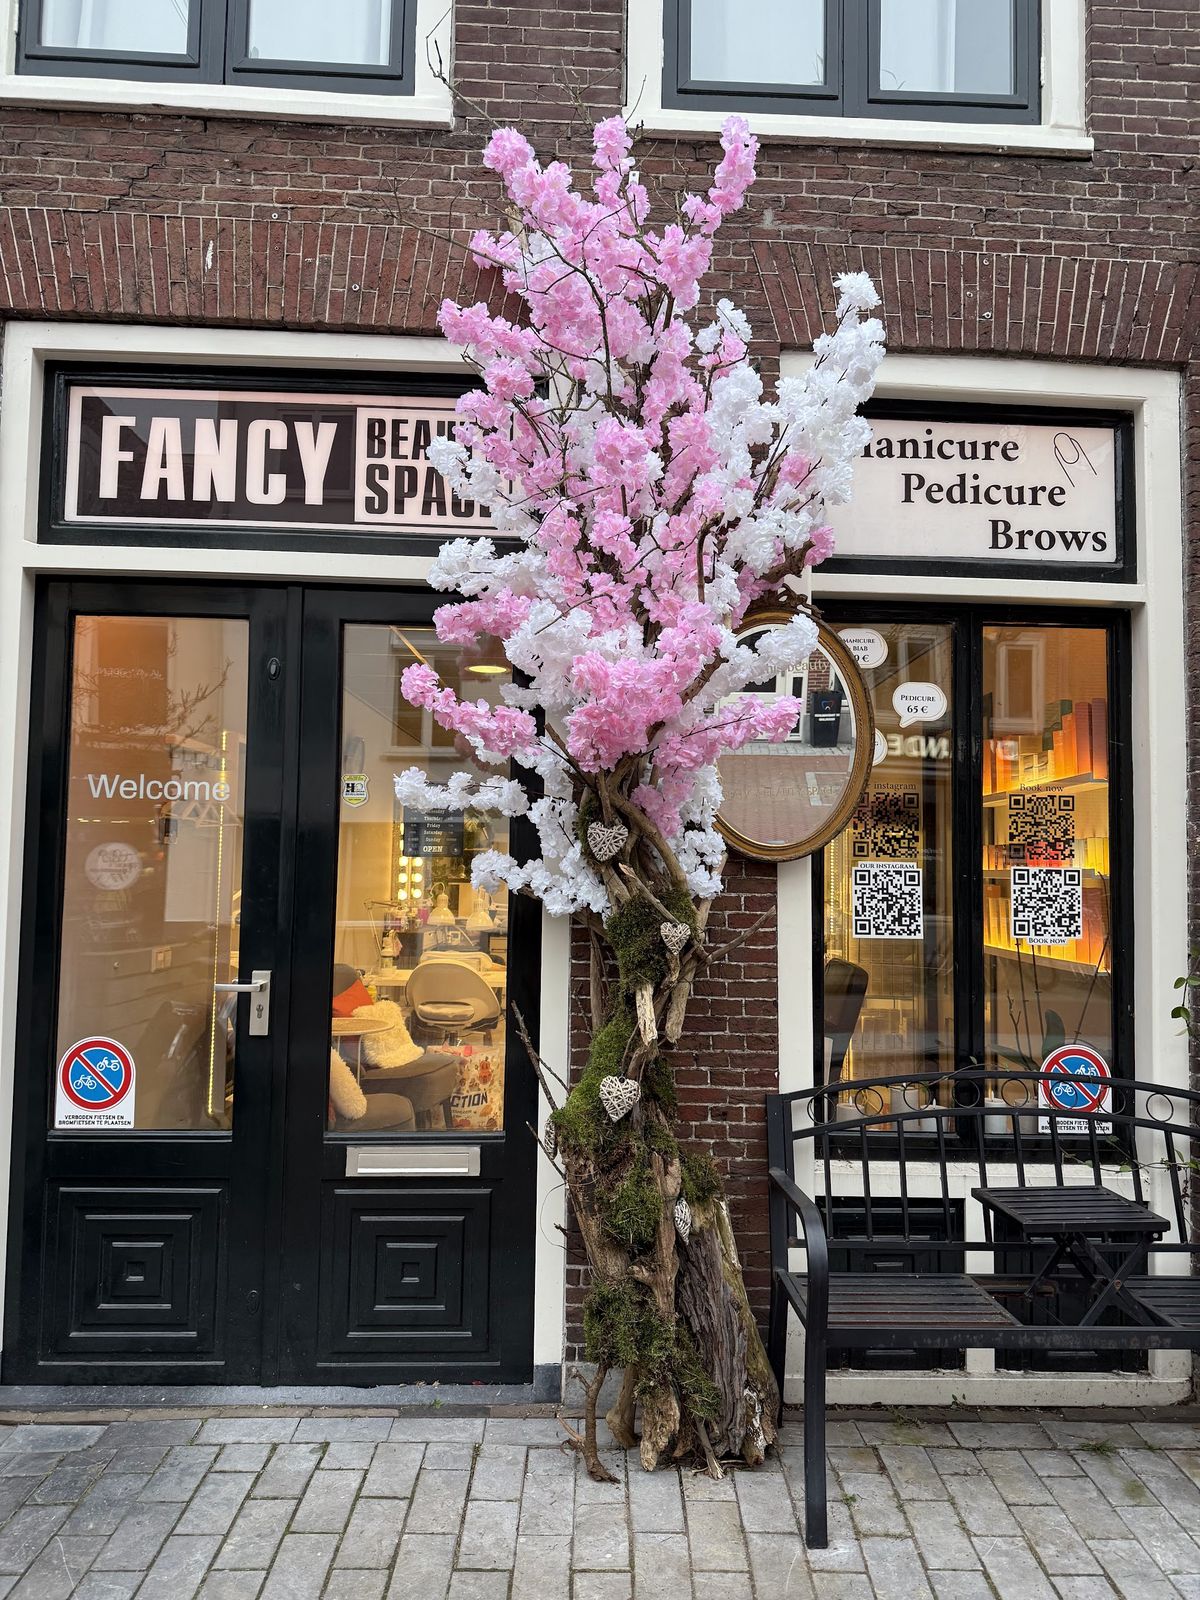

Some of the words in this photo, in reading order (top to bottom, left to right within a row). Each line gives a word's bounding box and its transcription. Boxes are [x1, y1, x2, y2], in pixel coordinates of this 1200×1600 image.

[367, 417, 485, 462] BEA
[860, 428, 1020, 462] anicure
[98, 414, 338, 506] FANCY
[364, 463, 493, 518] SPAC
[900, 473, 1067, 507] Pedicure
[988, 519, 1108, 552] Brows
[900, 694, 937, 702] PEDICURE
[906, 705, 919, 714] 65
[920, 705, 929, 714] €
[87, 773, 231, 801] Welcome
[873, 782, 917, 791] instagram
[1019, 783, 1042, 792] Book
[422, 845, 444, 853] OPEN
[450, 1091, 489, 1108] CTION
